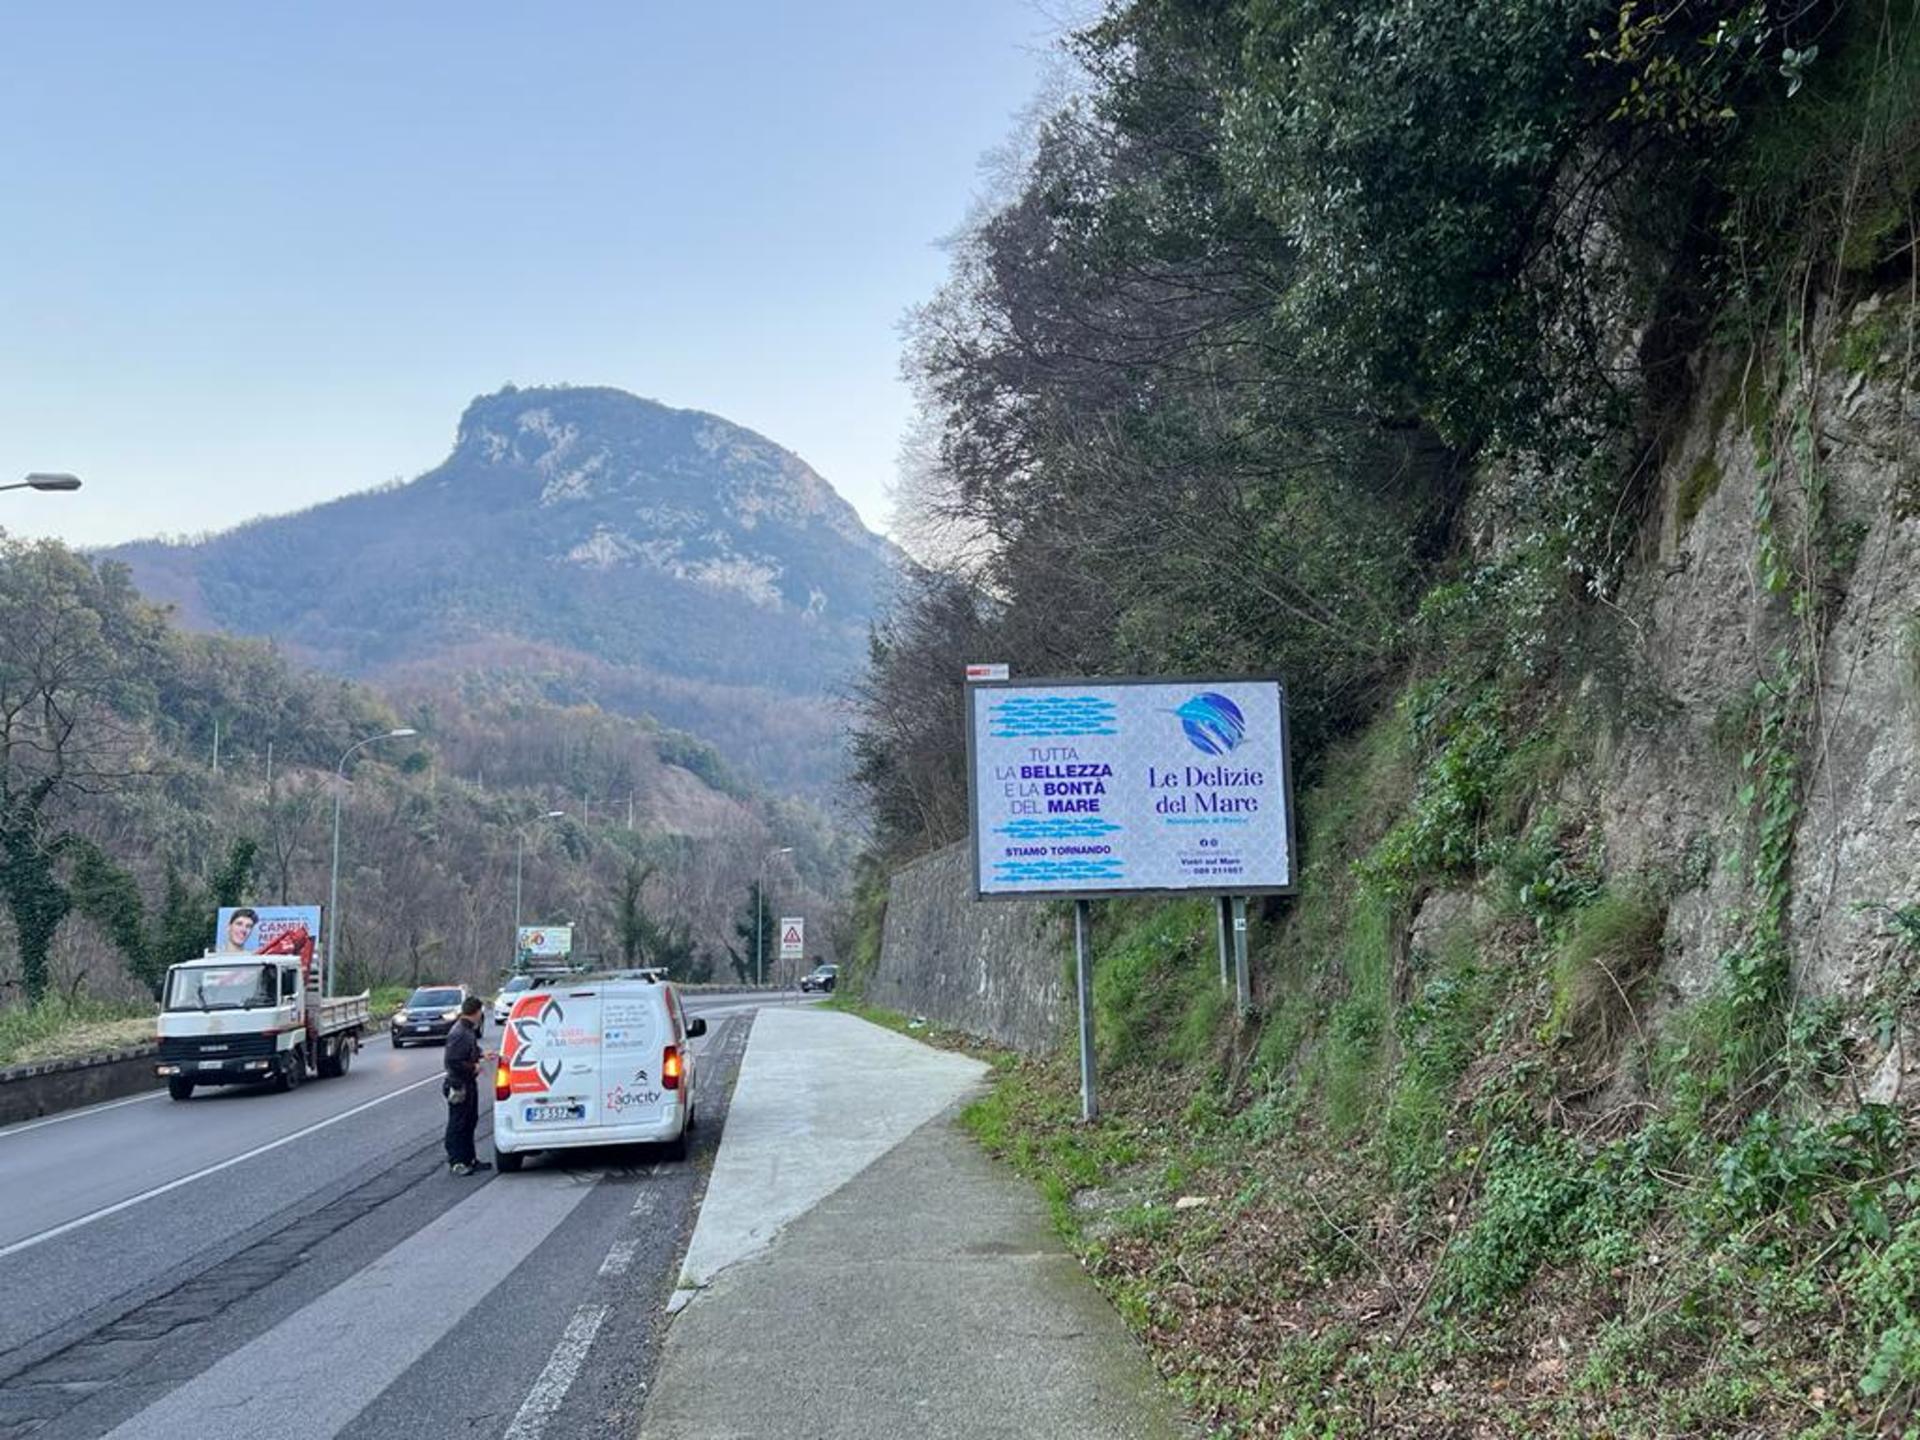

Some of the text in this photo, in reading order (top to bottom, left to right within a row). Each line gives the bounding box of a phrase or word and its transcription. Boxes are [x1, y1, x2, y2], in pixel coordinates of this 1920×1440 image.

[1028, 747, 1080, 762] TUTTA
[995, 763, 1113, 780] LA BELLEZZA
[1149, 766, 1264, 788] Le Delizie
[1004, 778, 1107, 797] E LA BONTÀ
[1011, 798, 1100, 814] DEL MARE
[1156, 792, 1259, 814] del Mare
[1005, 845, 1112, 857] STIAMO TORNANDO
